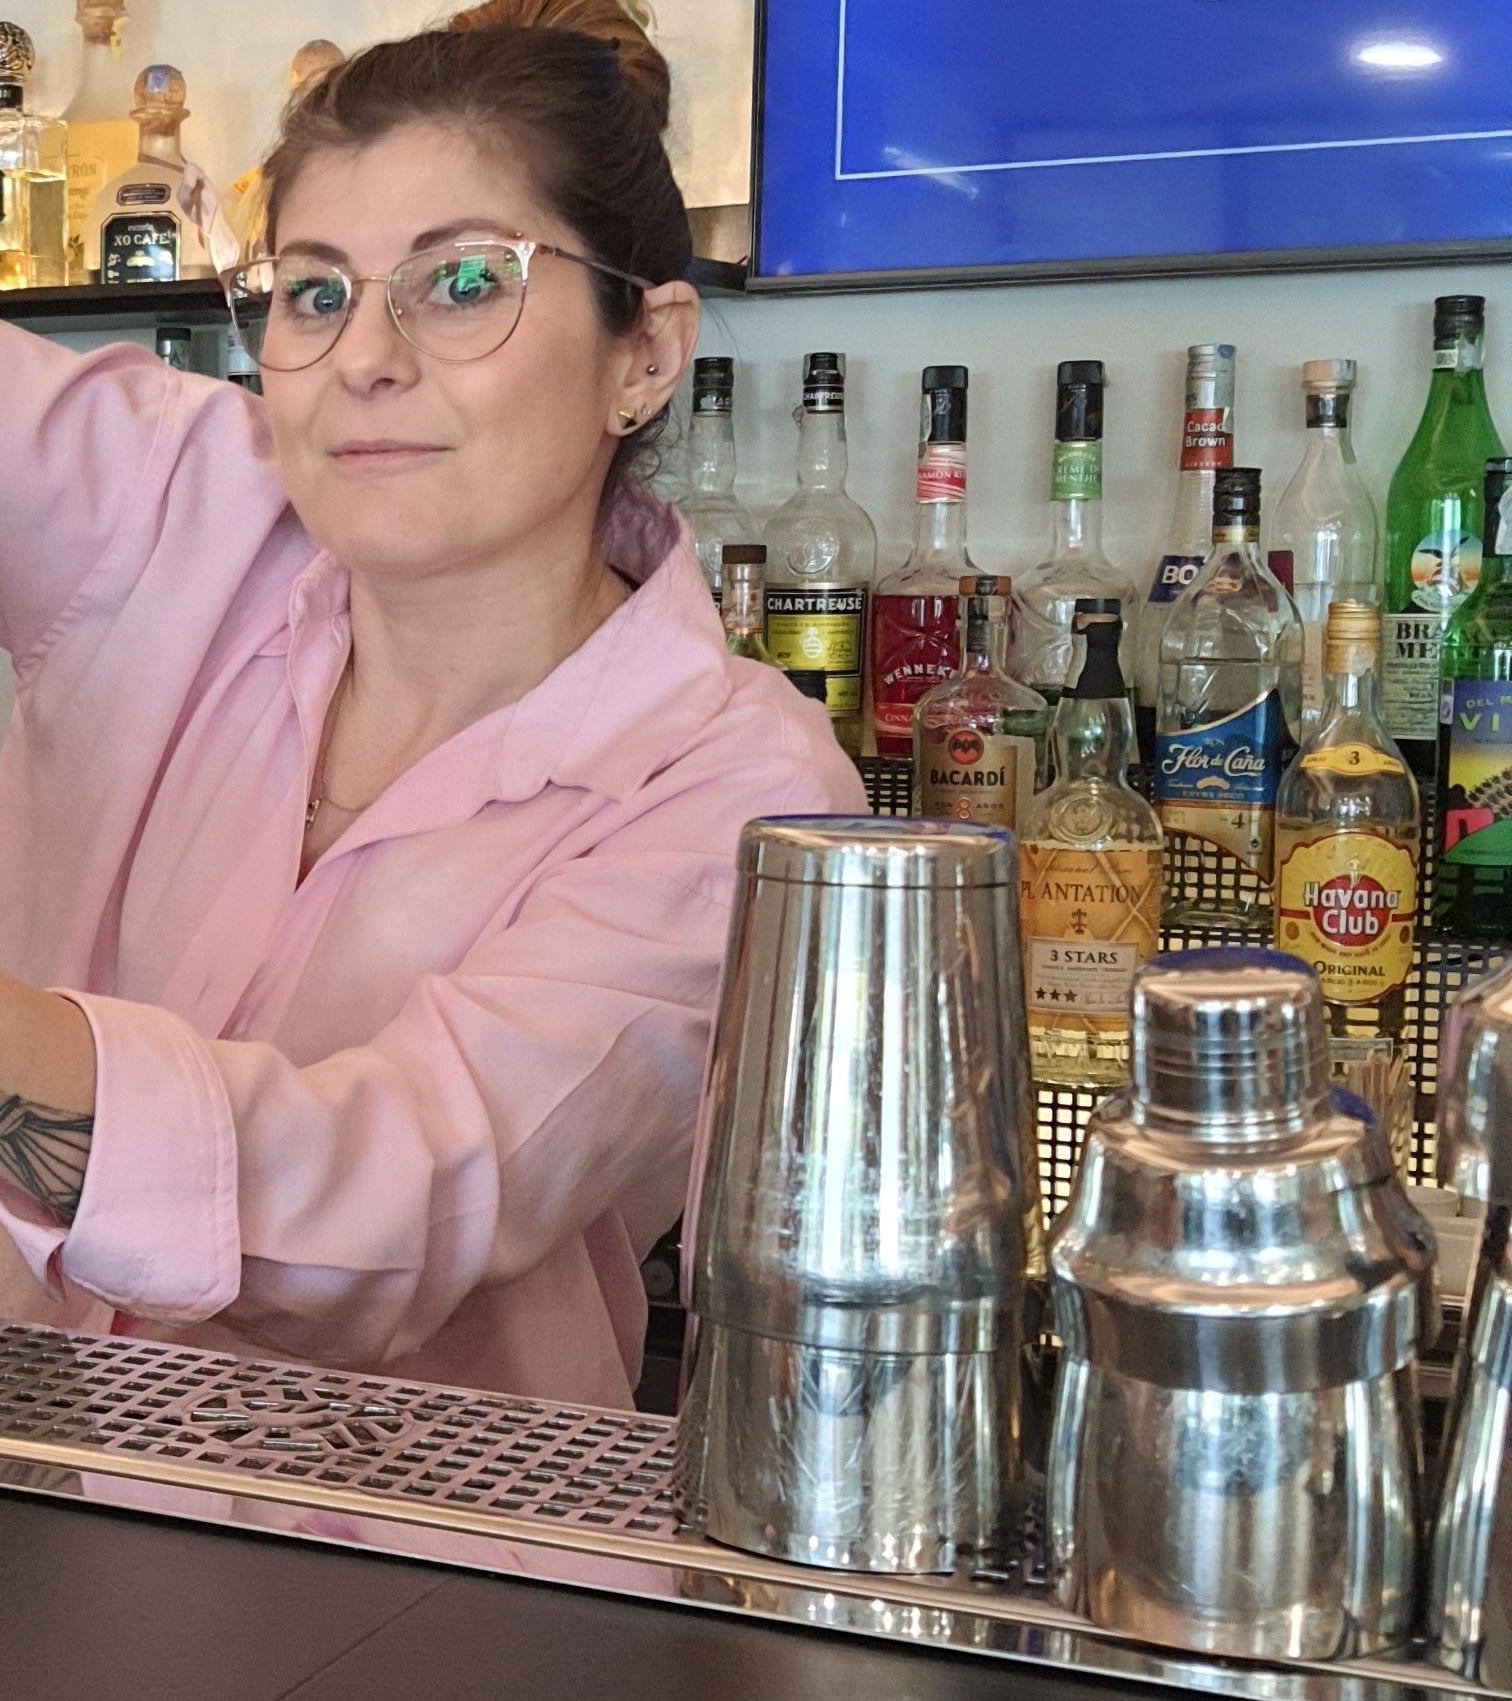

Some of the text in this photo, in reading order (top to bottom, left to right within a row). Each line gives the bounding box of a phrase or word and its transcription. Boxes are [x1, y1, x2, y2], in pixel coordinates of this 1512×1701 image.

[113, 235, 131, 246] XO
[1185, 436, 1226, 447] Brown
[1161, 565, 1200, 584] BO
[767, 596, 863, 611] CHARTREUSE
[884, 663, 958, 685] WENNEKE
[1459, 712, 1501, 731] VI
[1161, 743, 1209, 774] Flor
[1224, 746, 1266, 777] Caña
[1348, 750, 1361, 766] 3
[930, 766, 1006, 787] BACARDÍ
[955, 796, 973, 819] 8
[1230, 812, 1246, 830] 4
[1020, 880, 1142, 904] PLANTATION
[1303, 881, 1401, 909] Havana
[1321, 909, 1380, 936] Club
[1050, 949, 1118, 965] 3 STARS
[1313, 960, 1386, 977] ORIGINAL
